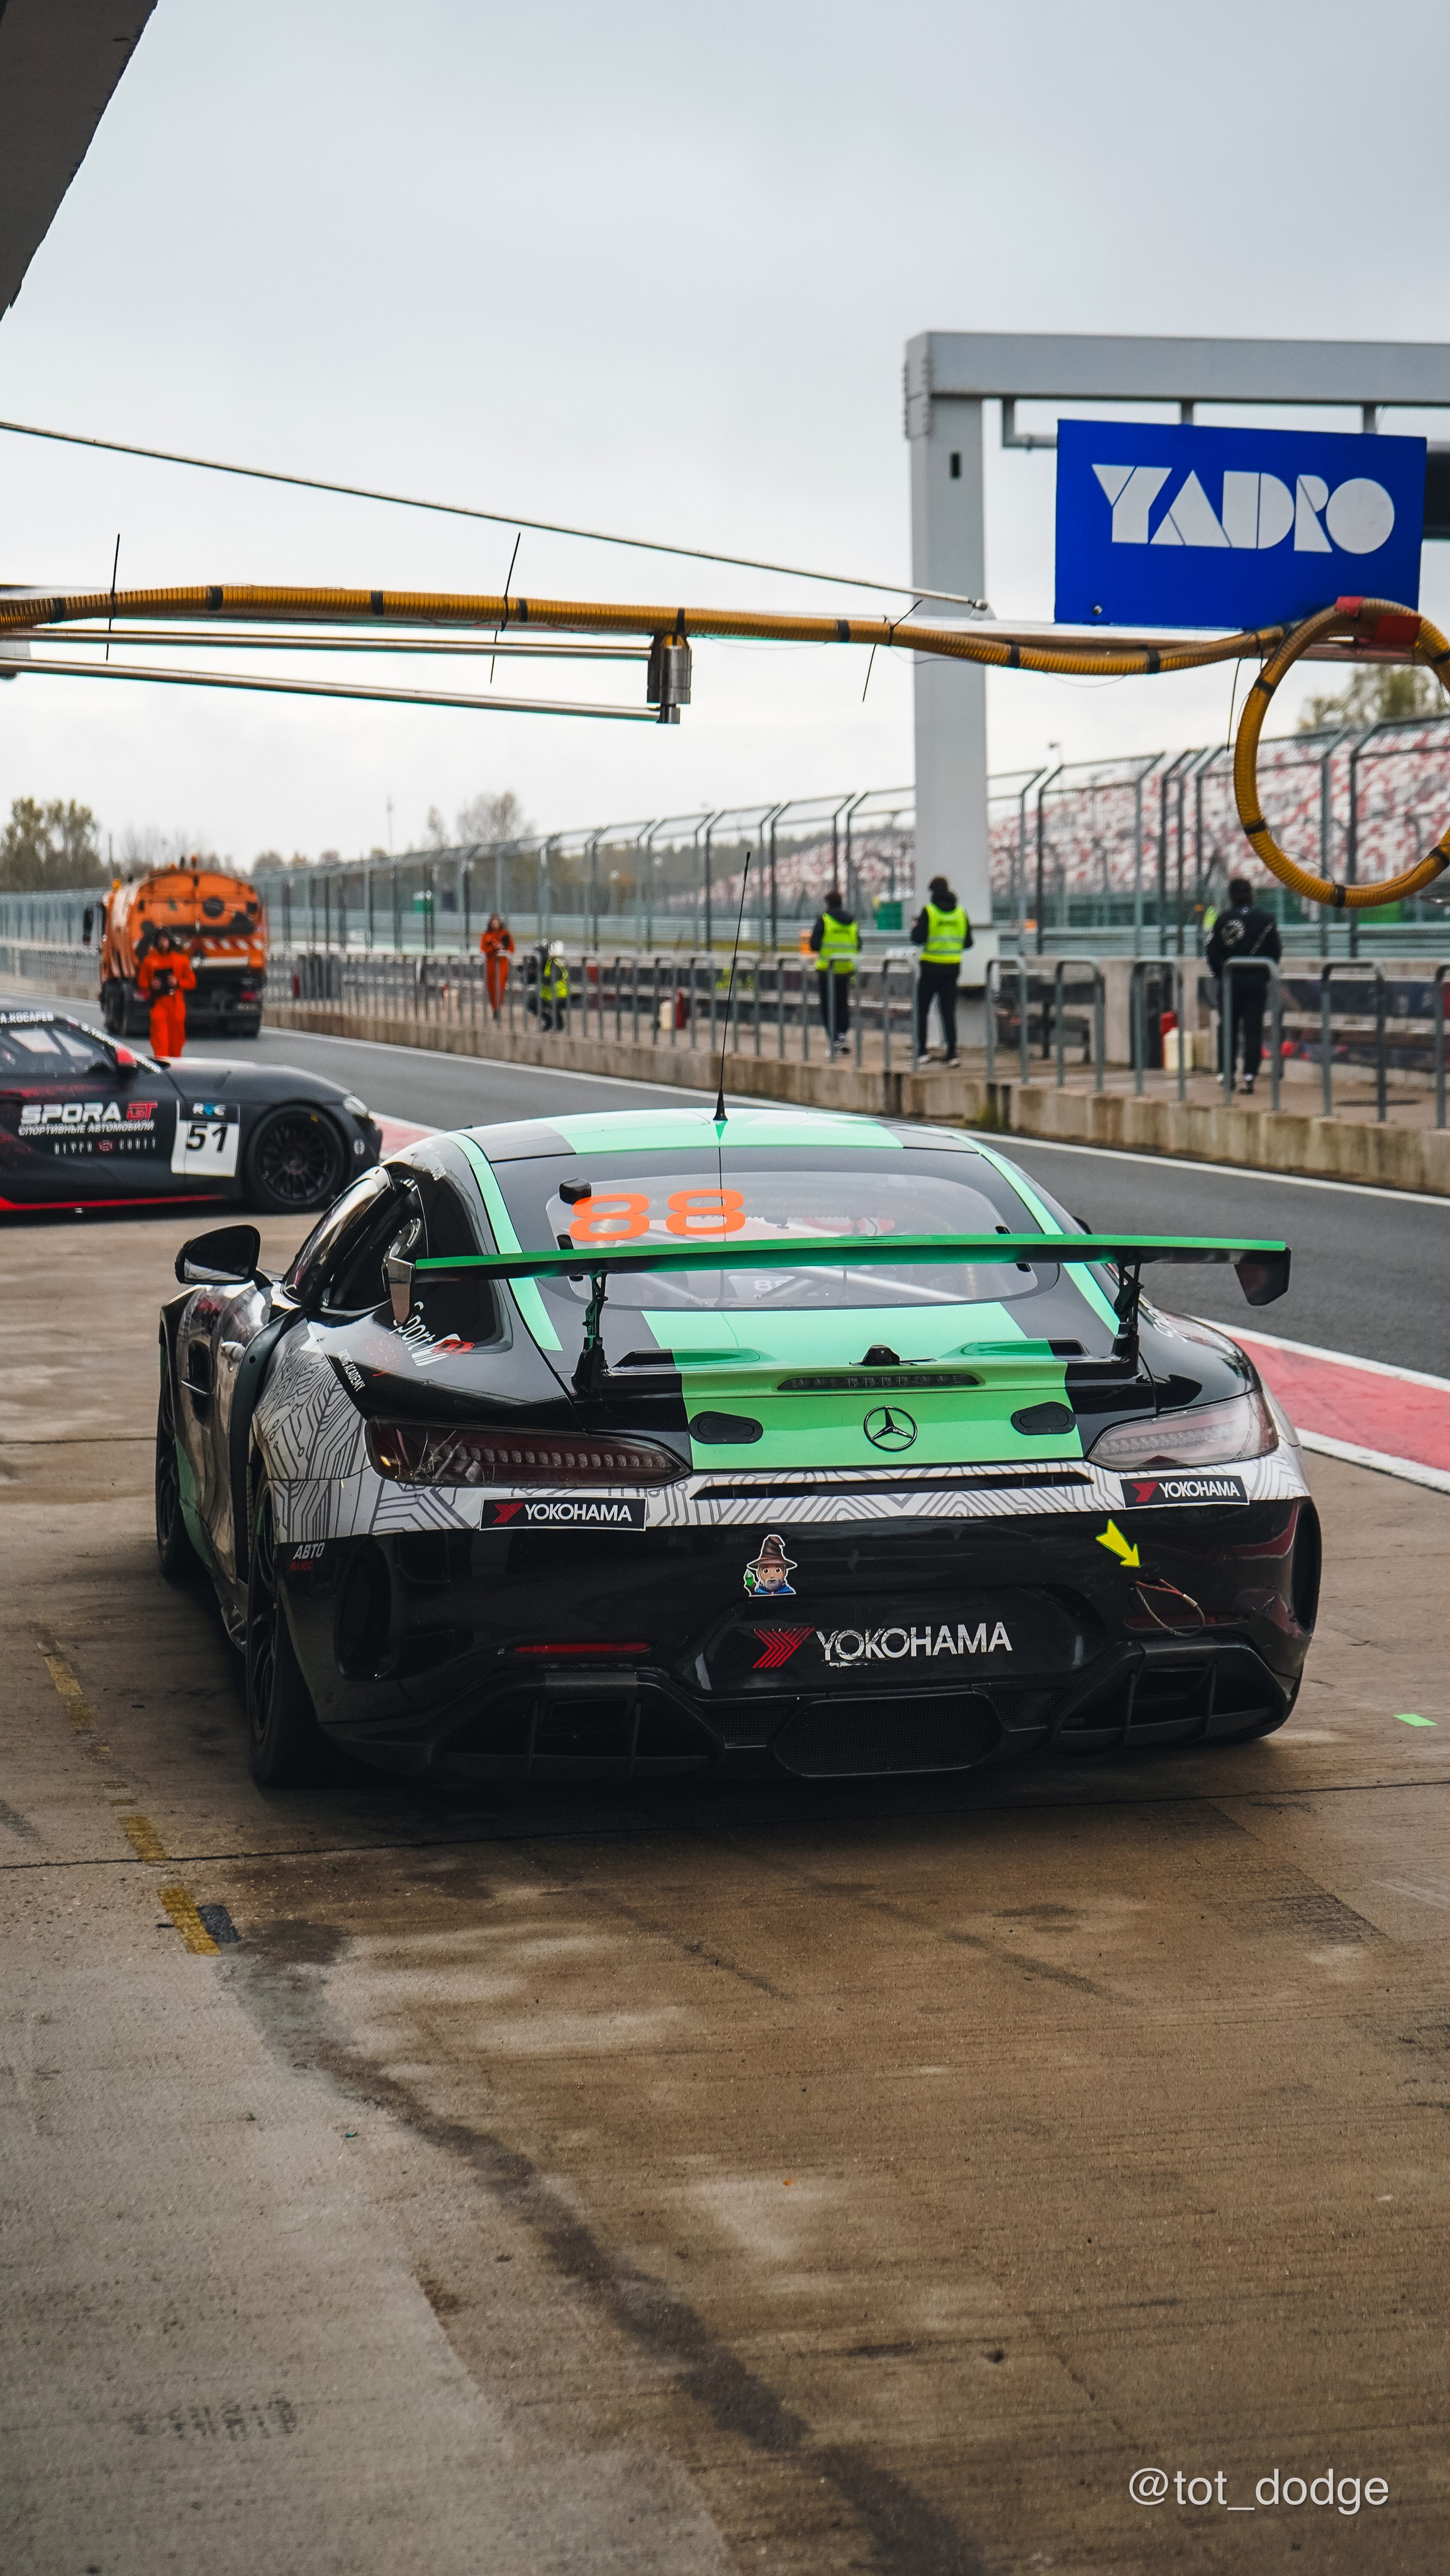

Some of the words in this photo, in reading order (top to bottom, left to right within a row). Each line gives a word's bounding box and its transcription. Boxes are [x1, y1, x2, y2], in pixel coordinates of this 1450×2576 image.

[1091, 464, 1395, 555] YADRO
[21, 1102, 121, 1124] SPORA
[126, 1101, 159, 1121] GT
[18, 1123, 86, 1136] СПОРТИВНЫЕ
[87, 1120, 155, 1133] АВТОМОБИЛИ
[186, 1123, 228, 1153] 51
[569, 1189, 745, 1242] 88
[344, 1360, 366, 1392] ACADEMY
[1158, 1480, 1241, 1498] YOKOHAMA
[525, 1503, 632, 1522] YOKOHAMA
[293, 1542, 325, 1560] АВТО
[816, 1621, 1013, 1661] YOKOHAMA
